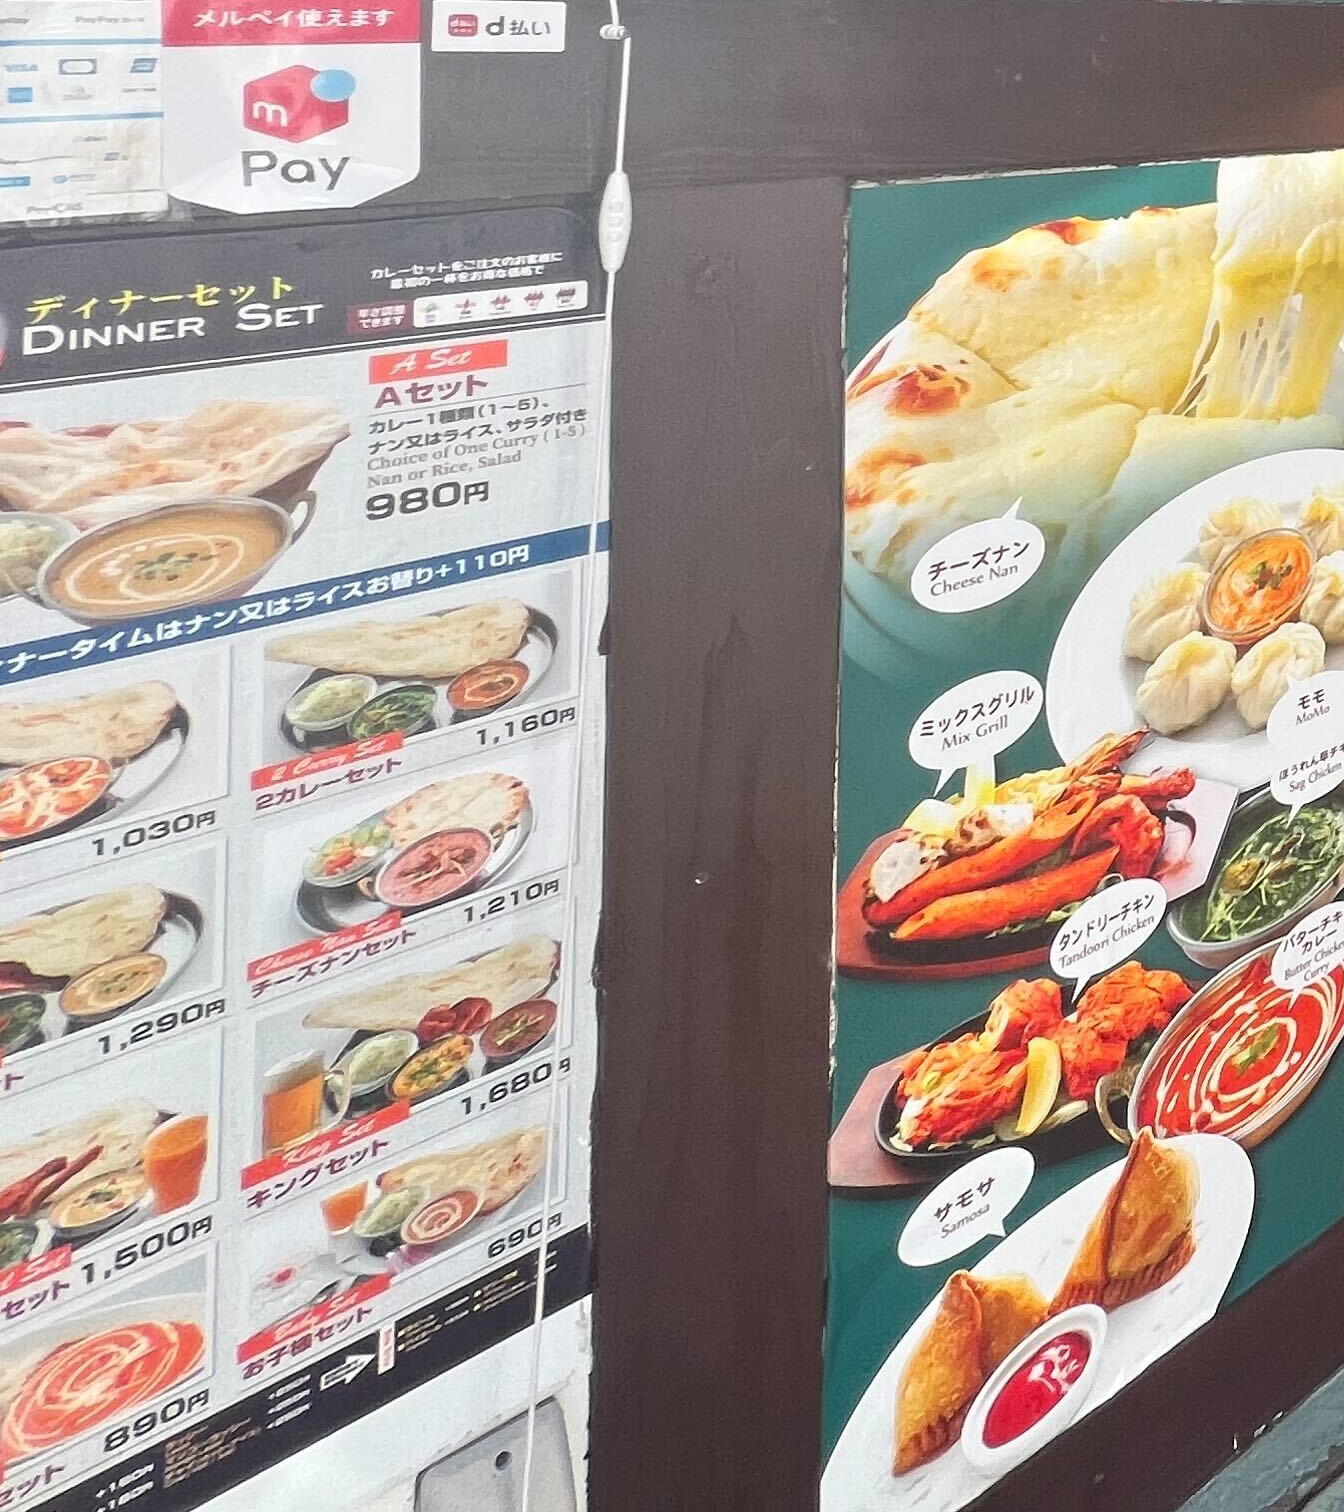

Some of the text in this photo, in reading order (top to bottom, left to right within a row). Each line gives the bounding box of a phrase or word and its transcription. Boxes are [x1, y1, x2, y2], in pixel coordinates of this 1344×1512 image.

[193, 7, 395, 30] メルペイ使えます
[241, 148, 350, 192] Pay
[25, 276, 294, 323] ディナーセット
[368, 434, 537, 472] Choice One Curry
[368, 450, 522, 488] Nan Salad
[366, 480, 489, 521] 980円
[928, 541, 1030, 582] チーズナン
[930, 561, 1019, 597] Cheese Nan
[0, 543, 530, 672] ナータイムはナン又はライスお替り+110円
[920, 684, 1036, 738] ミックスグリル
[1298, 688, 1326, 710] モモ
[476, 707, 576, 746] 1,160円
[941, 713, 1010, 753] Mix Grill
[255, 758, 403, 812] 2カレーセット
[1308, 760, 1343, 784] Chicken
[91, 810, 216, 857] 1,030円
[464, 877, 560, 923] 1,210円
[1058, 894, 1156, 951] タンドリーチキン
[251, 929, 416, 999] チーズナンセット
[1059, 913, 1156, 972] Tandoori Chicken
[1301, 928, 1338, 956] カレー
[98, 997, 227, 1056] 1,290円
[247, 1138, 389, 1210] キングセット
[934, 1175, 997, 1223] サモサ
[940, 1202, 992, 1240] Samosa
[82, 1214, 213, 1286] 1,500円
[103, 1389, 210, 1454] 890円
